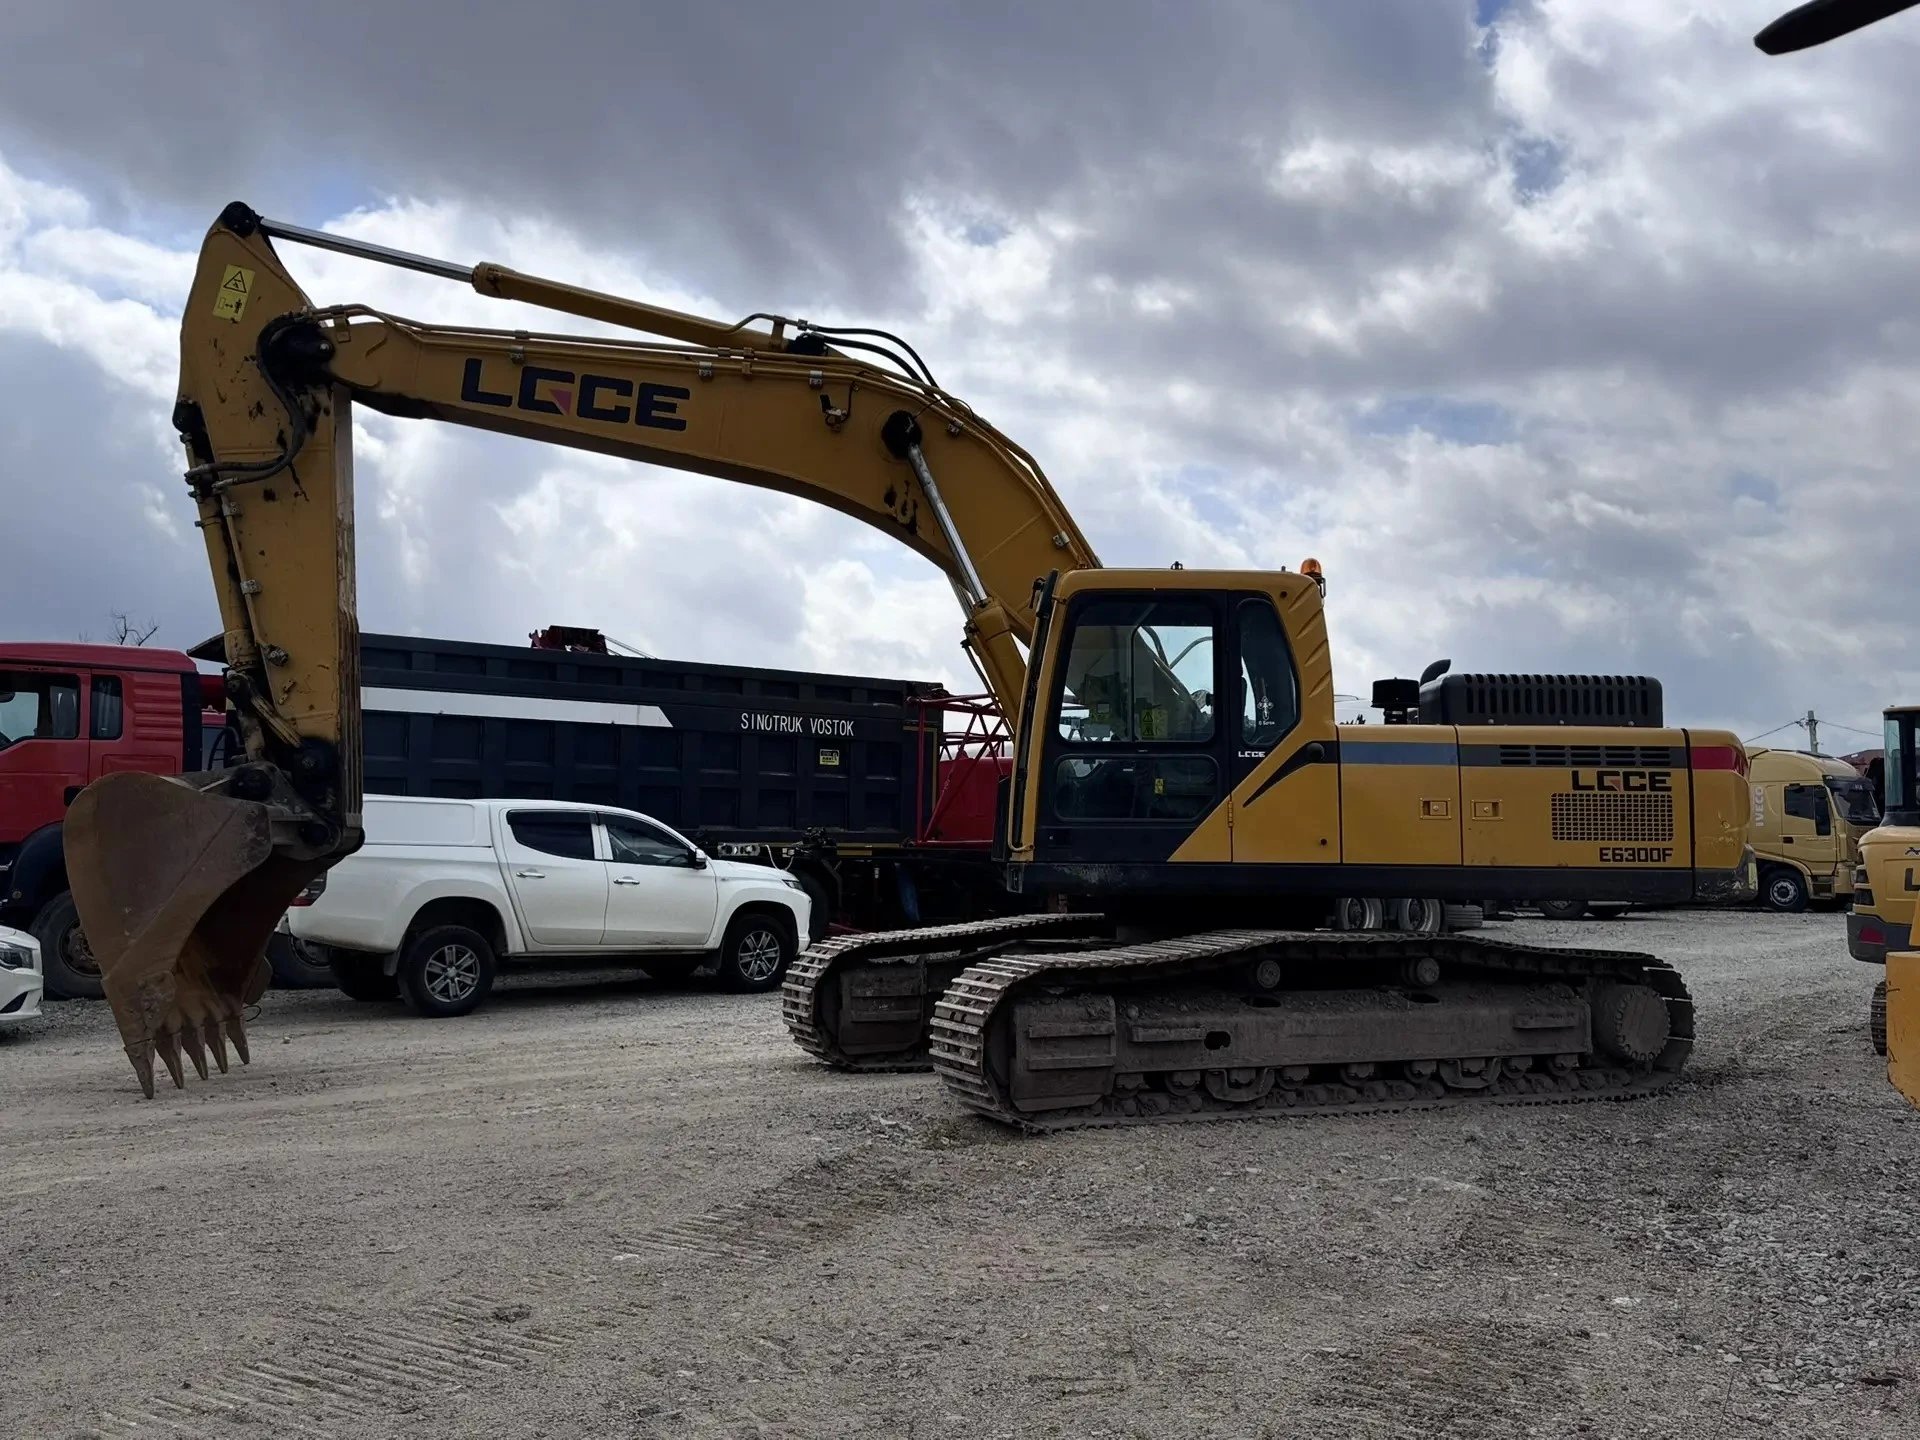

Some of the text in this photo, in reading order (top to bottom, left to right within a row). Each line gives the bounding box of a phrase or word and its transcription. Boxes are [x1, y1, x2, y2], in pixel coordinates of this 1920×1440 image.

[461, 357, 691, 431] LGCE
[740, 713, 854, 736] SINOTRUK VOSTOK
[1571, 770, 1672, 792] LGCE
[1753, 786, 1764, 826] IVECO
[1599, 847, 1674, 863] E6300F
